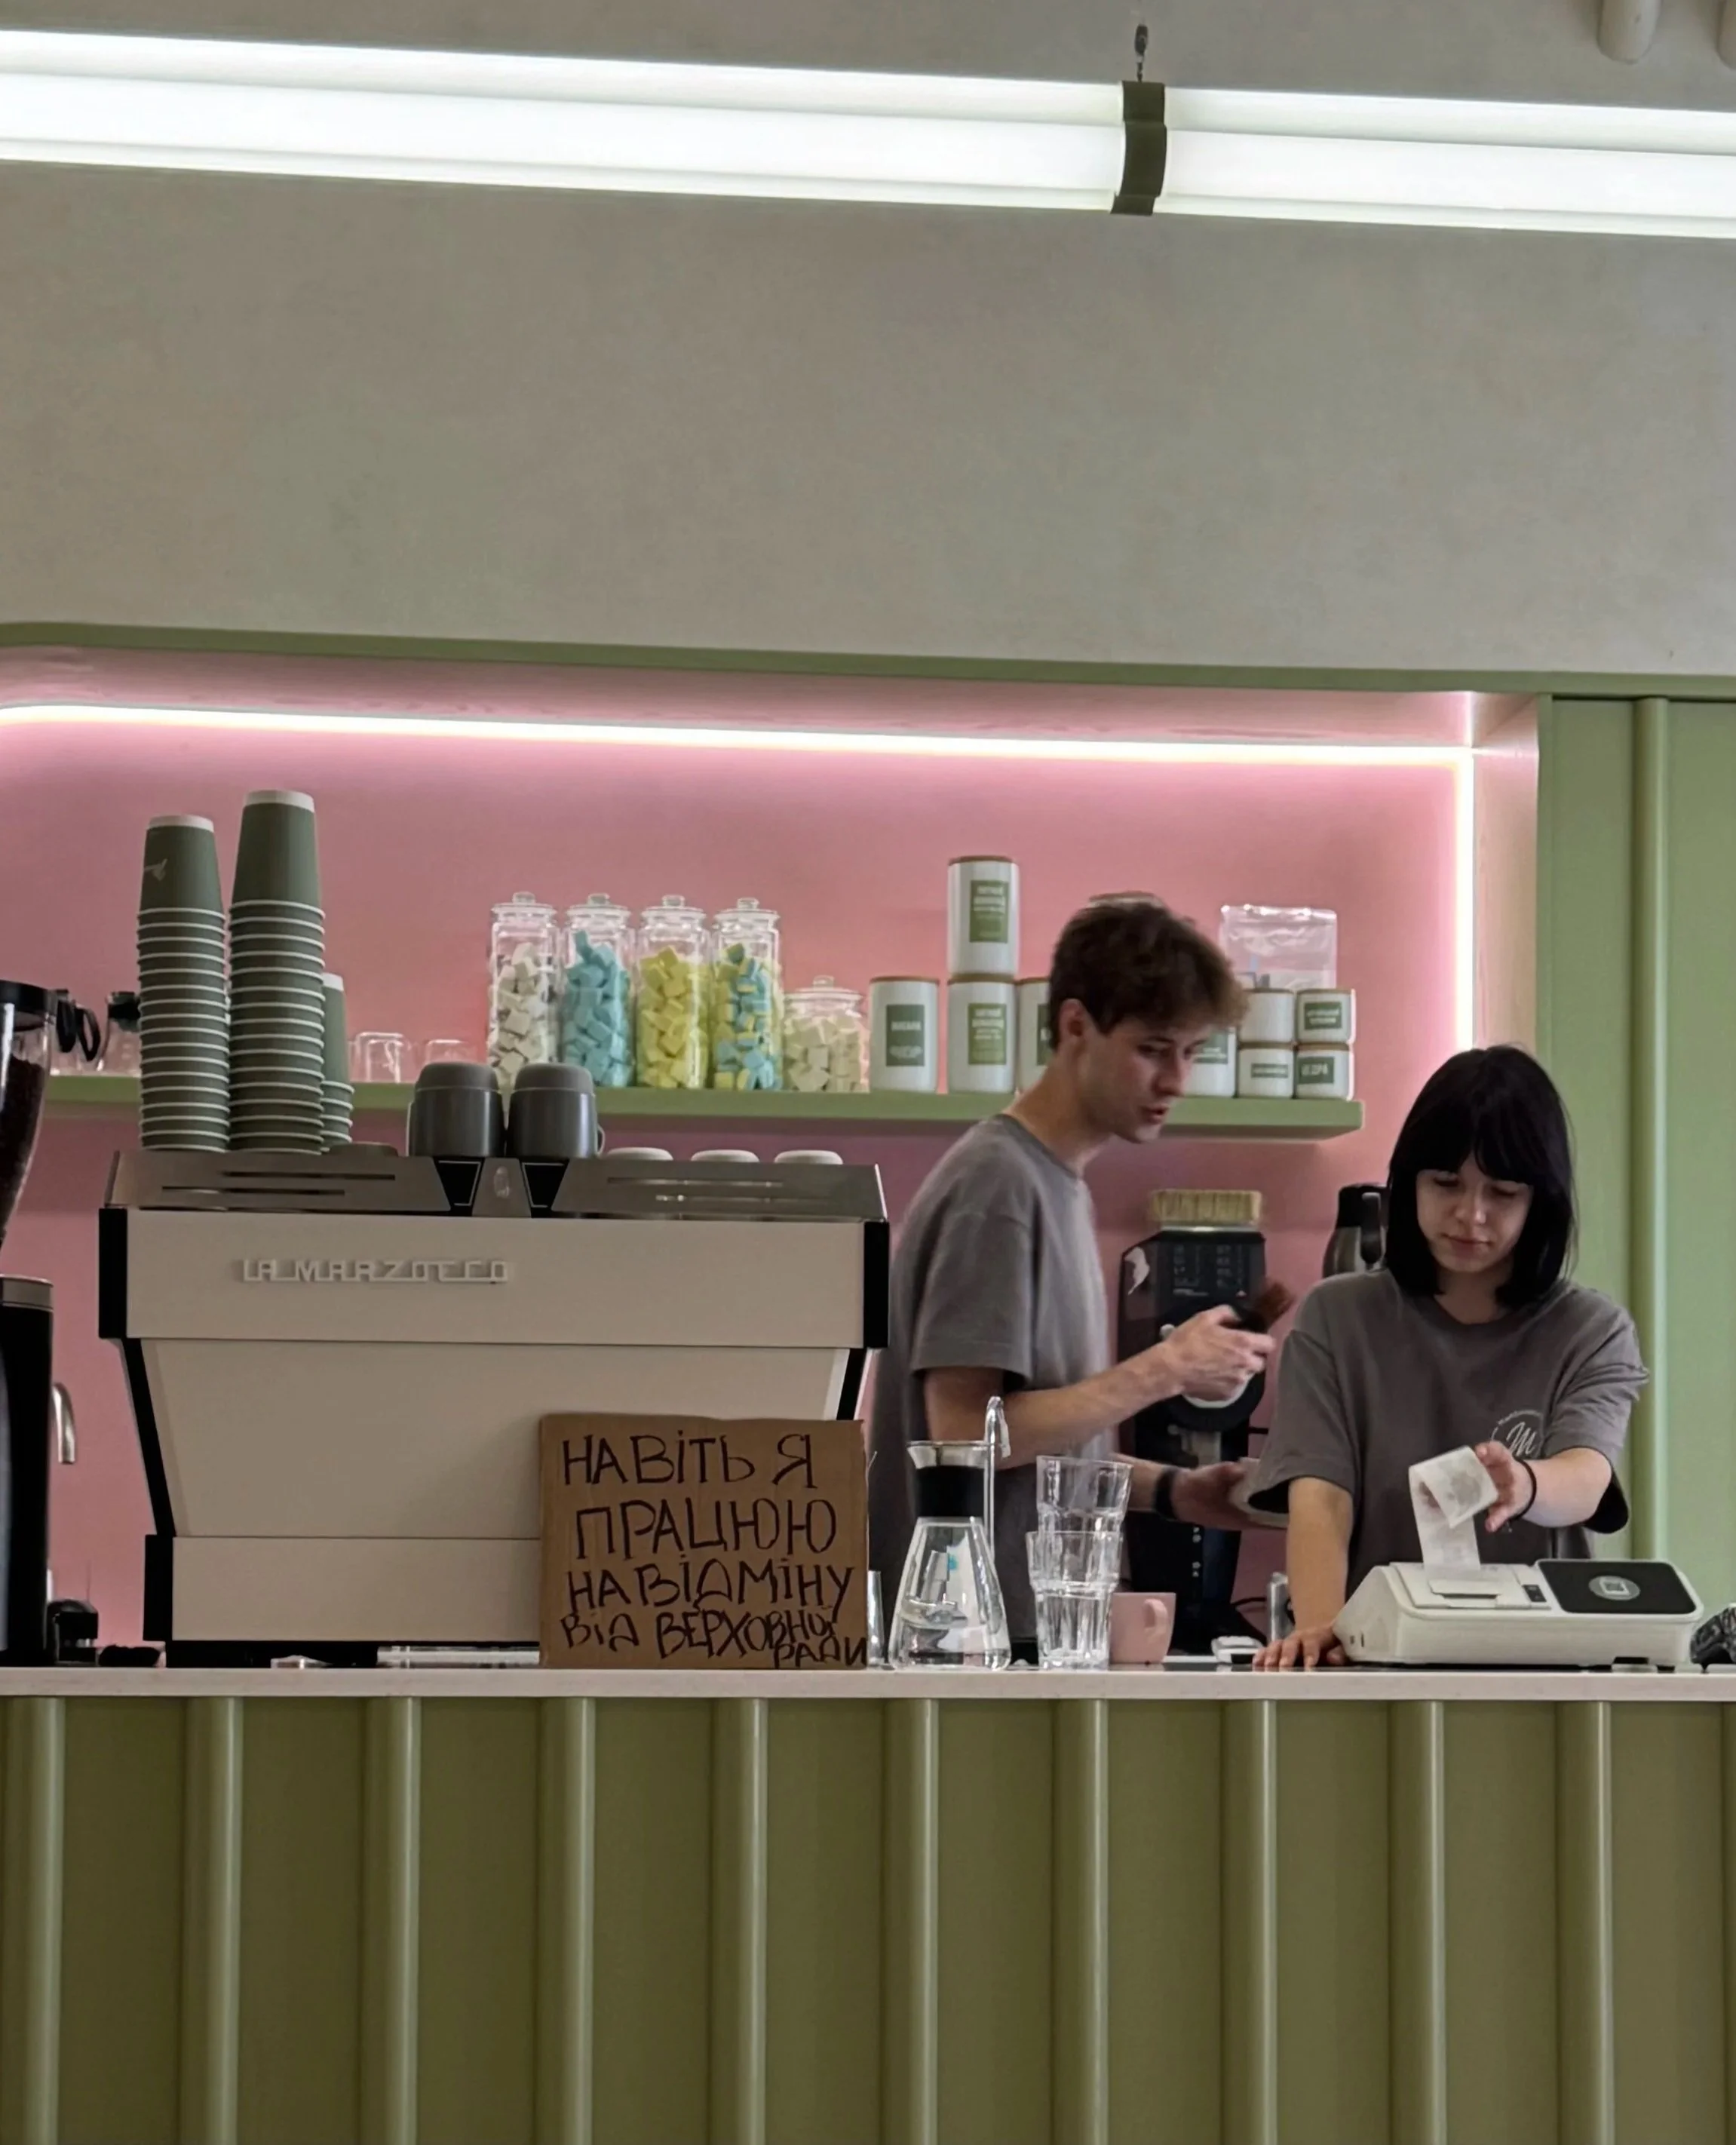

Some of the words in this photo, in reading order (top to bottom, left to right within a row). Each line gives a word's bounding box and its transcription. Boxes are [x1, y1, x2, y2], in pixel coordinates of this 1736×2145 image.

[243, 1259, 277, 1282] LA
[562, 1430, 756, 1485] НАВІТЬ
[771, 1433, 818, 1490] Я
[575, 1496, 837, 1560] ПРАЦЮЮ
[773, 1635, 867, 1670] РАДИ
